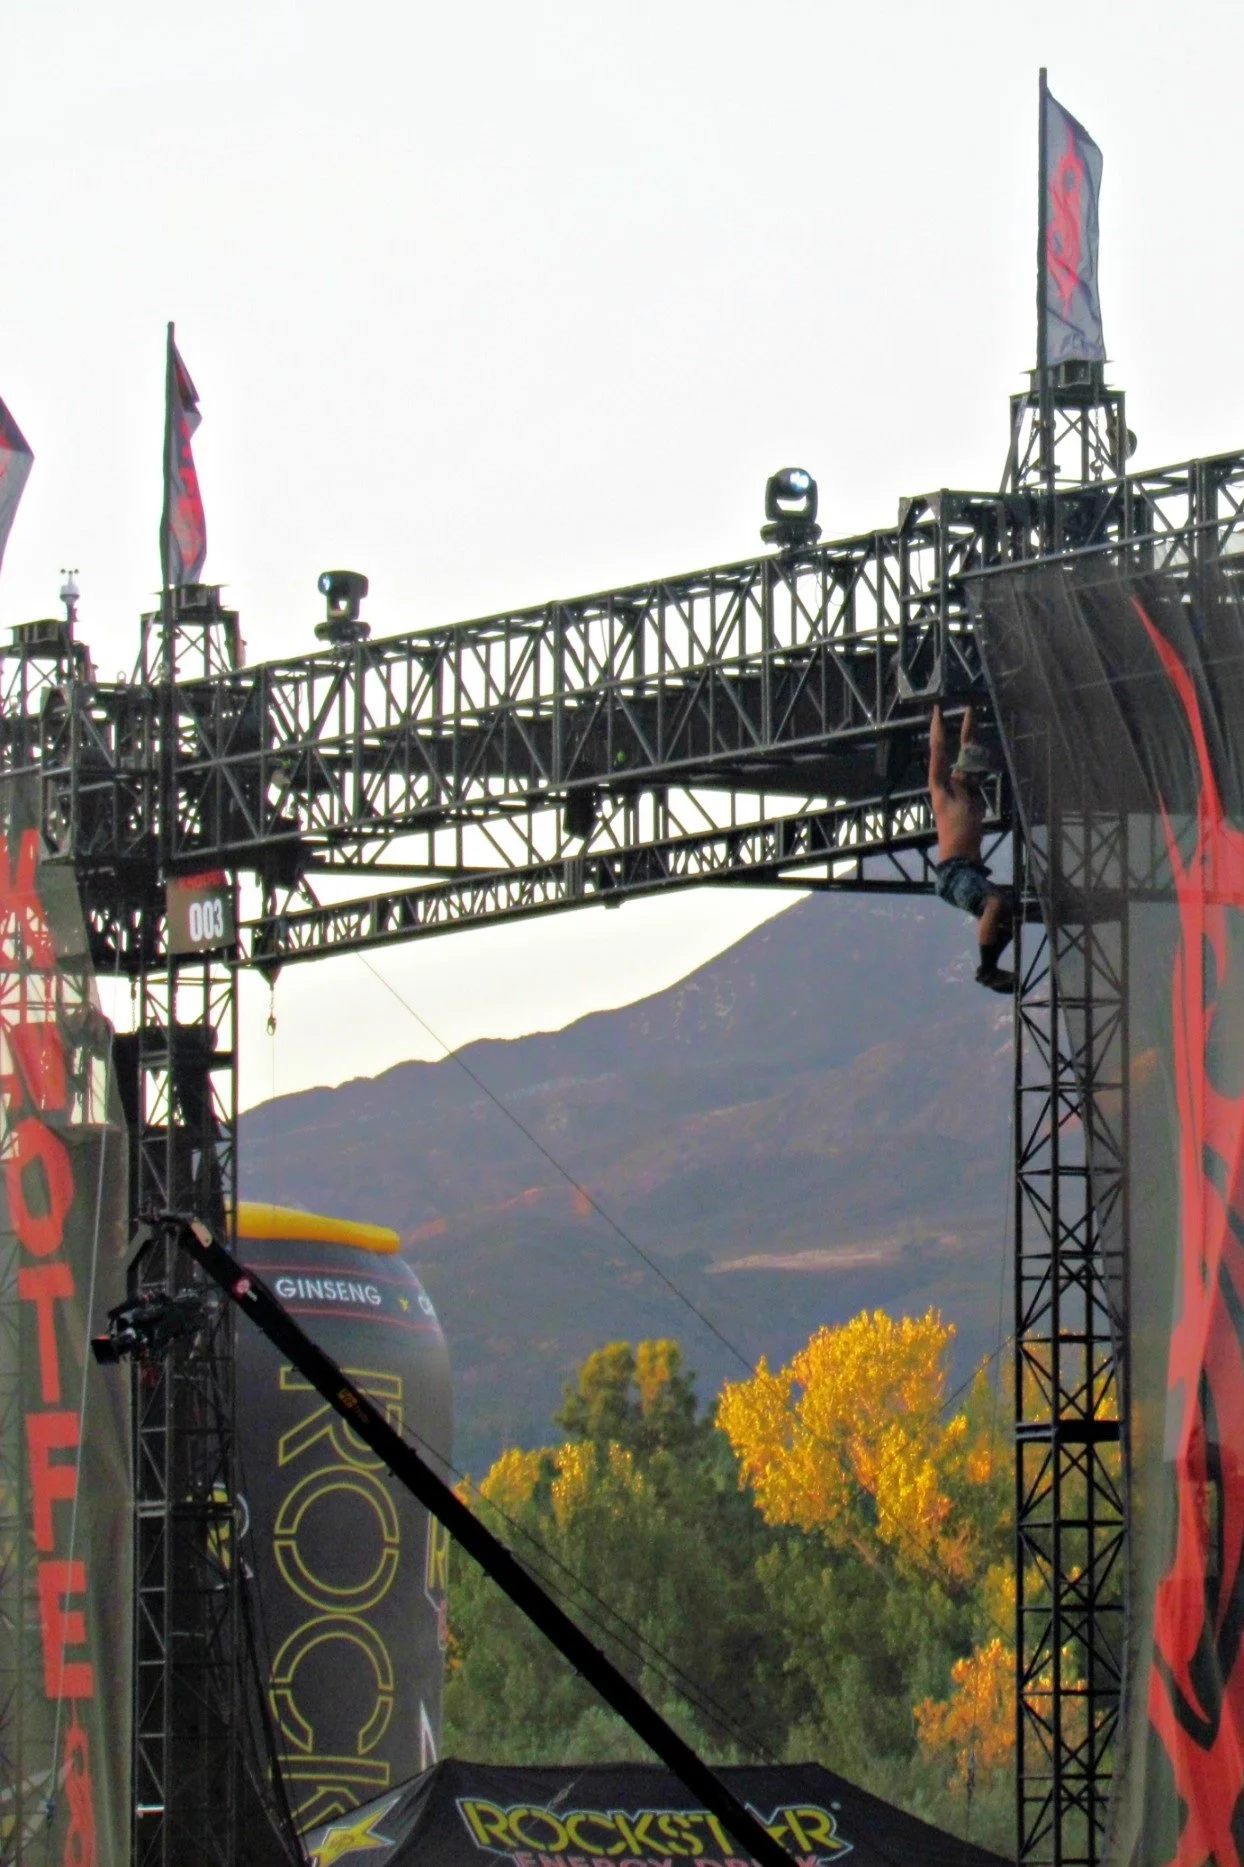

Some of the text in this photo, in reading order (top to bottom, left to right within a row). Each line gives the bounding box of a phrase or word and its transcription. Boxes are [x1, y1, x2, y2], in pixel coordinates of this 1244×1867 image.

[189, 899, 224, 942] 003
[275, 1277, 382, 1306] GINSENG
[464, 1801, 842, 1856] ROCKSTR
